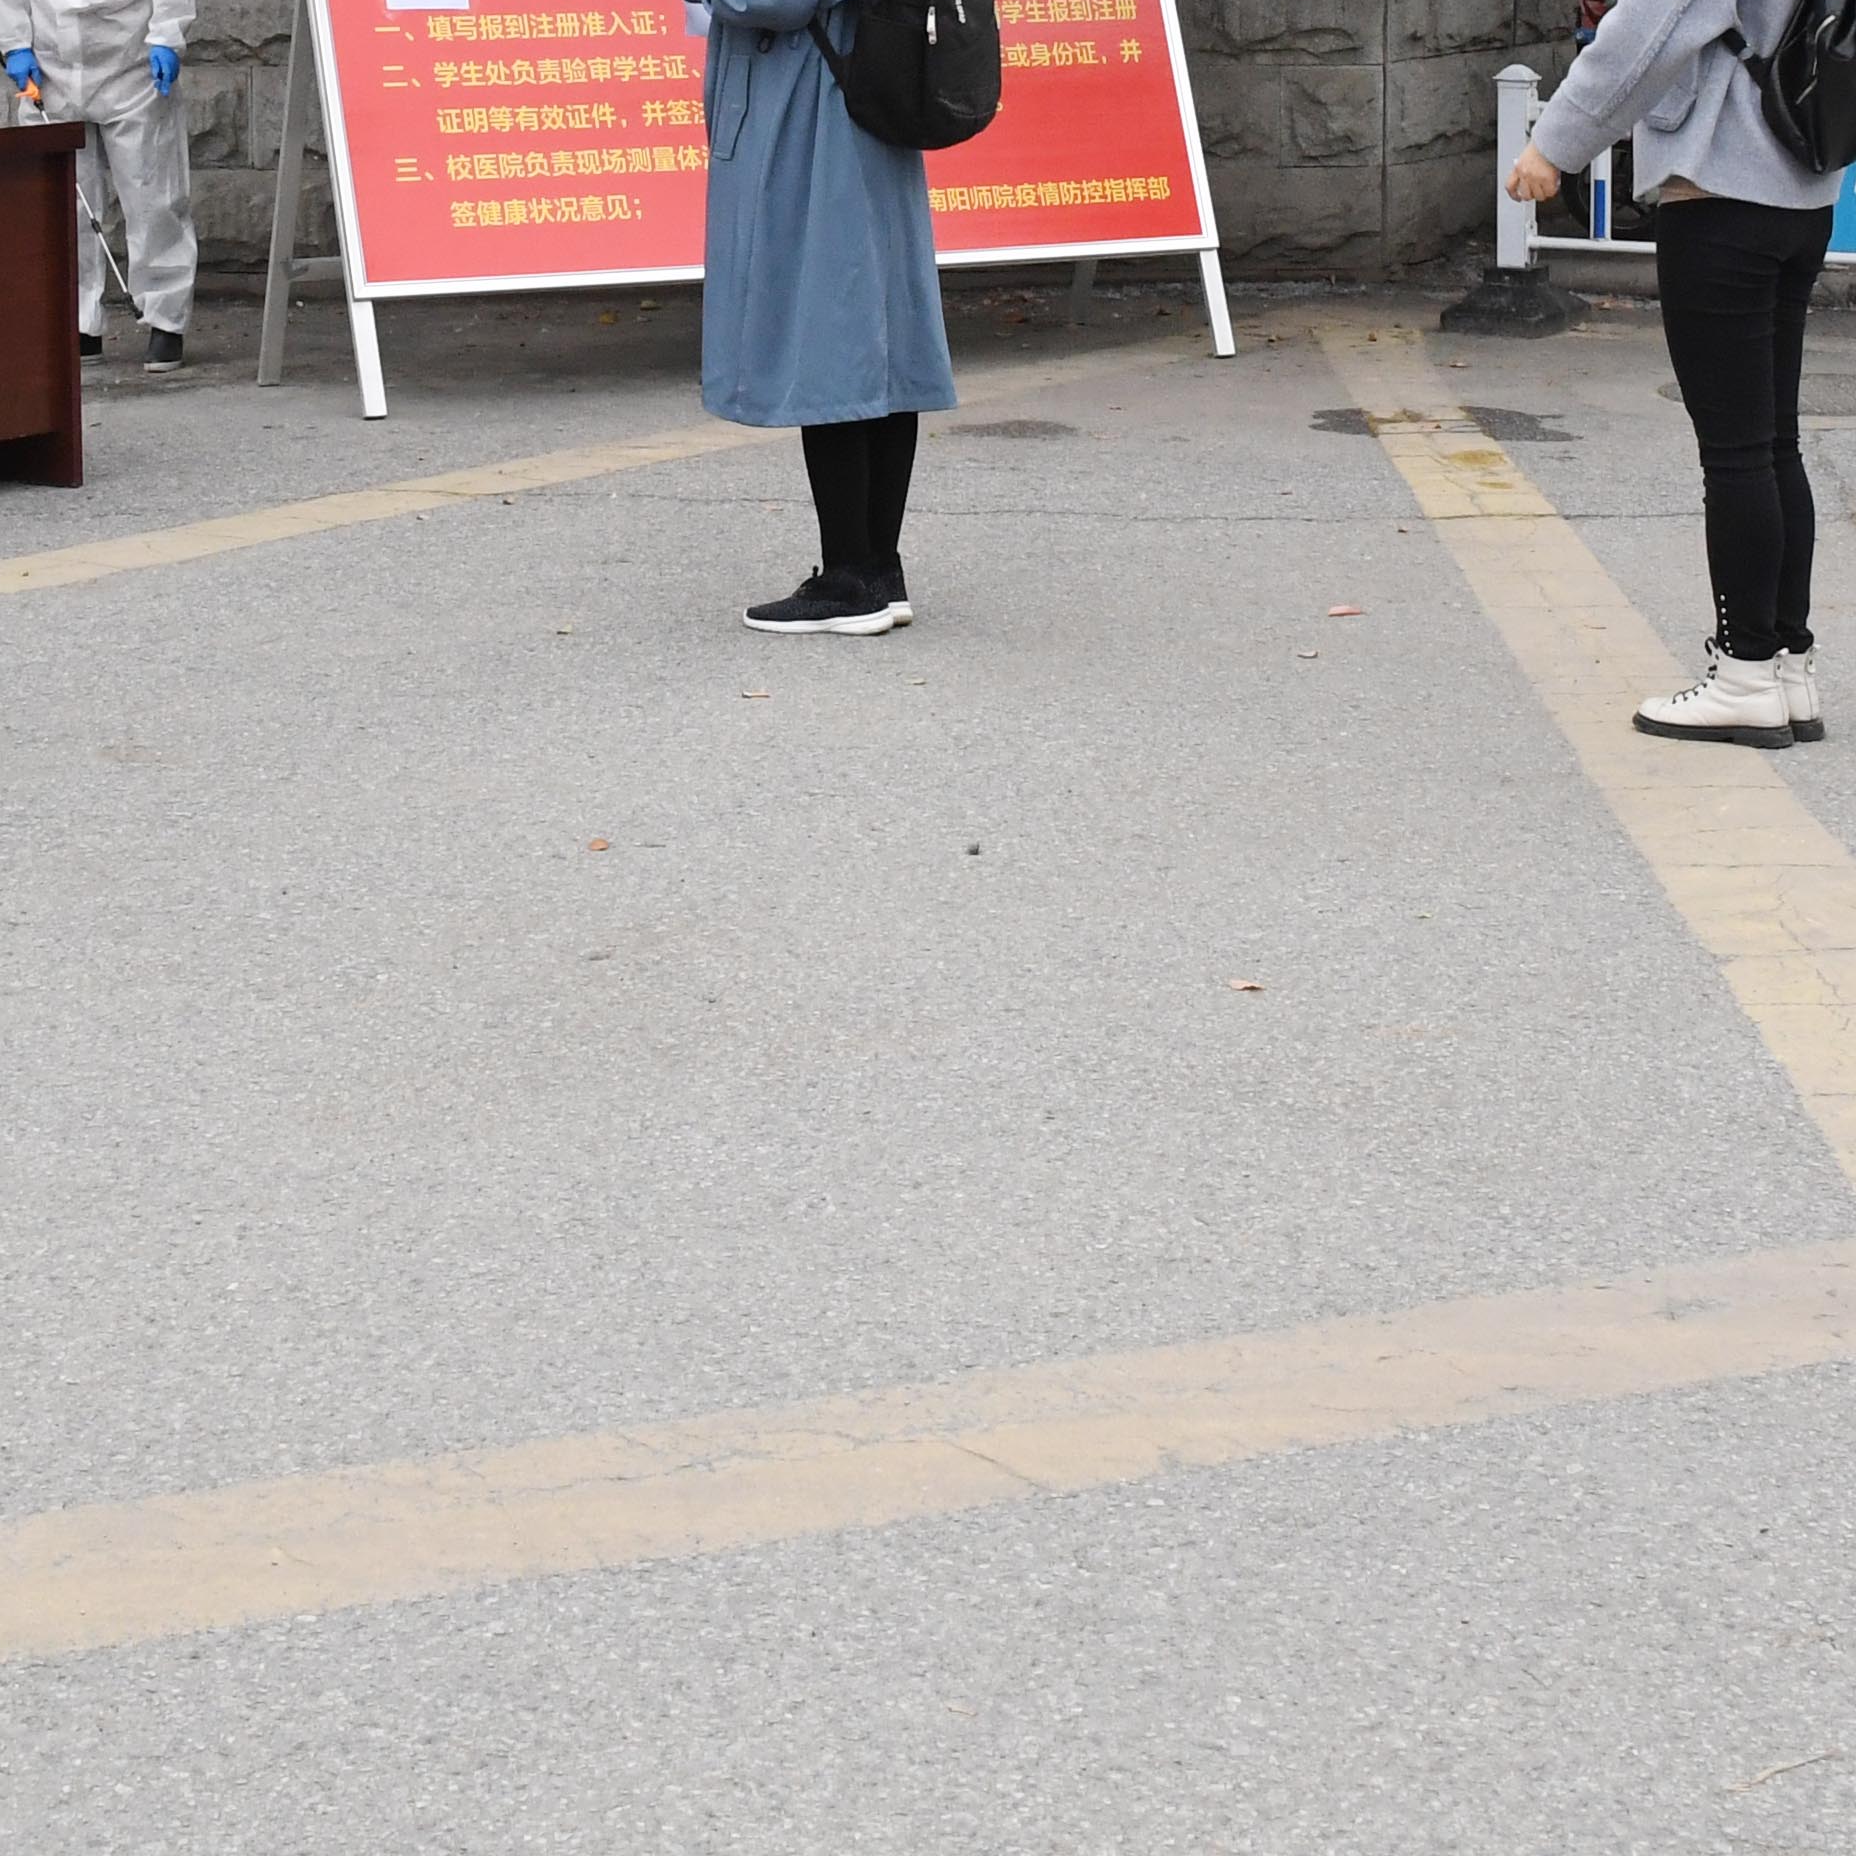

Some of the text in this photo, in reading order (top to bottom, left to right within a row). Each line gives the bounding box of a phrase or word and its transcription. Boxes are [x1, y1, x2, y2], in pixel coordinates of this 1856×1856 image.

[395, 145, 710, 182] 三、校医院负责现场测量体
[928, 176, 1171, 213] 南阳师院疫情防控指挥部
